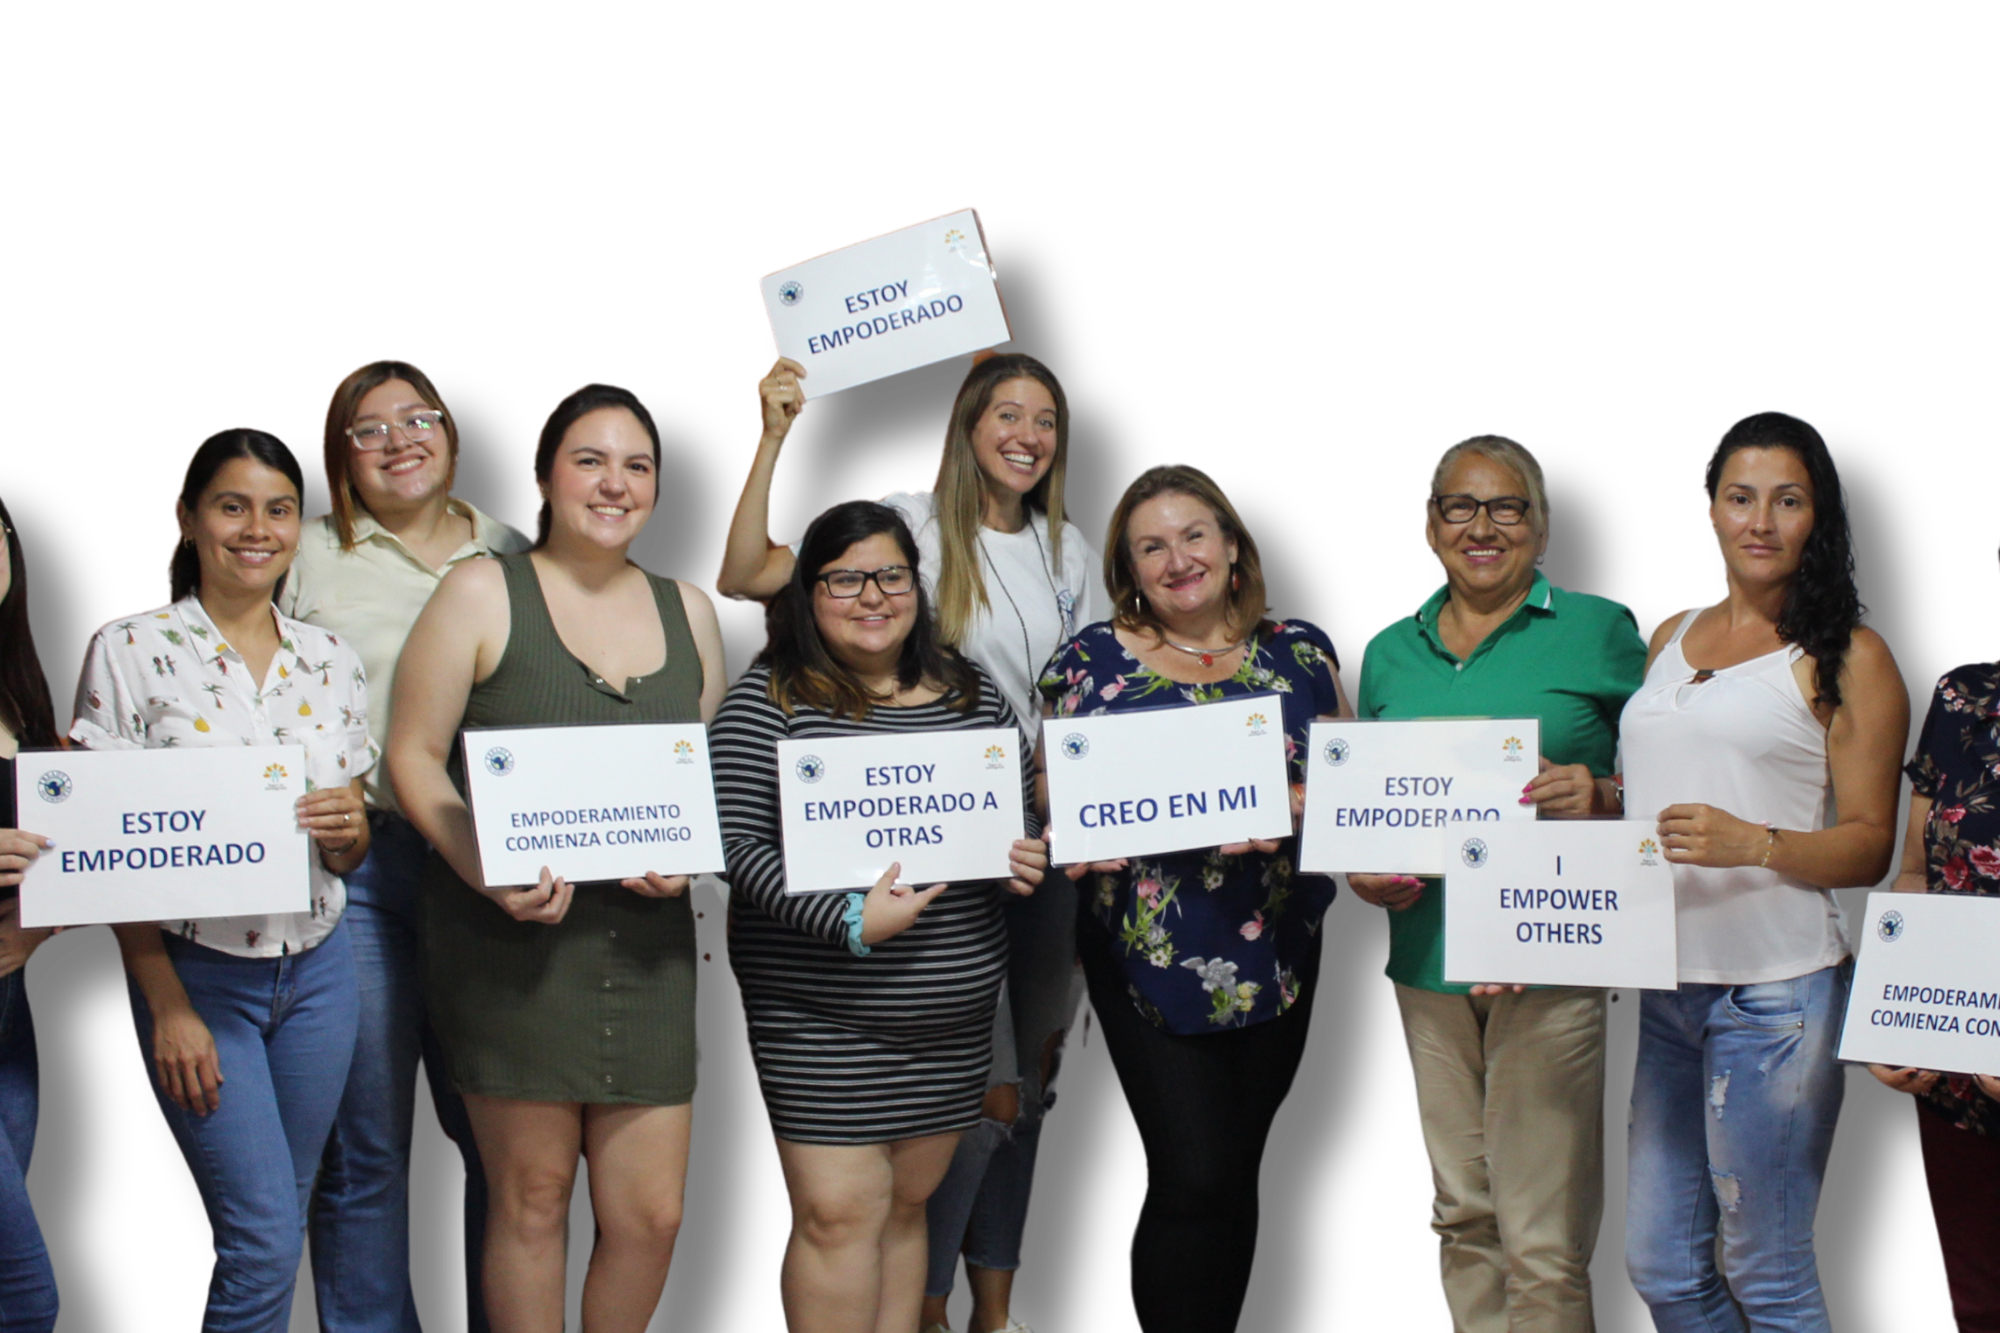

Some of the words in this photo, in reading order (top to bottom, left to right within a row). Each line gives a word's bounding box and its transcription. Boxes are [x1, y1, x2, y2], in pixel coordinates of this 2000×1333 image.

[845, 280, 907, 314] ESTOY
[808, 295, 962, 354] EMPODERADO
[866, 764, 935, 786] ESTOY
[1385, 777, 1453, 796] ESTOY
[511, 805, 680, 827] EMPODERAMIENTO
[805, 793, 975, 821] EMPODERADO
[983, 791, 998, 810] A
[1079, 798, 1158, 828] CREO
[1169, 791, 1207, 818] EN
[1219, 785, 1256, 812] MI
[1336, 808, 1500, 827] EMPODERADO
[122, 810, 206, 834] ESTOY
[506, 832, 601, 851] COMIENZA
[606, 827, 691, 845] CONMIGO
[866, 825, 943, 848] OTRAS
[62, 842, 265, 873] EMPODERADO
[1556, 855, 1562, 876] I
[1500, 888, 1618, 911] EMPOWER
[1516, 922, 1602, 945] OTHERS
[1871, 1009, 1960, 1033] COMIENZA
